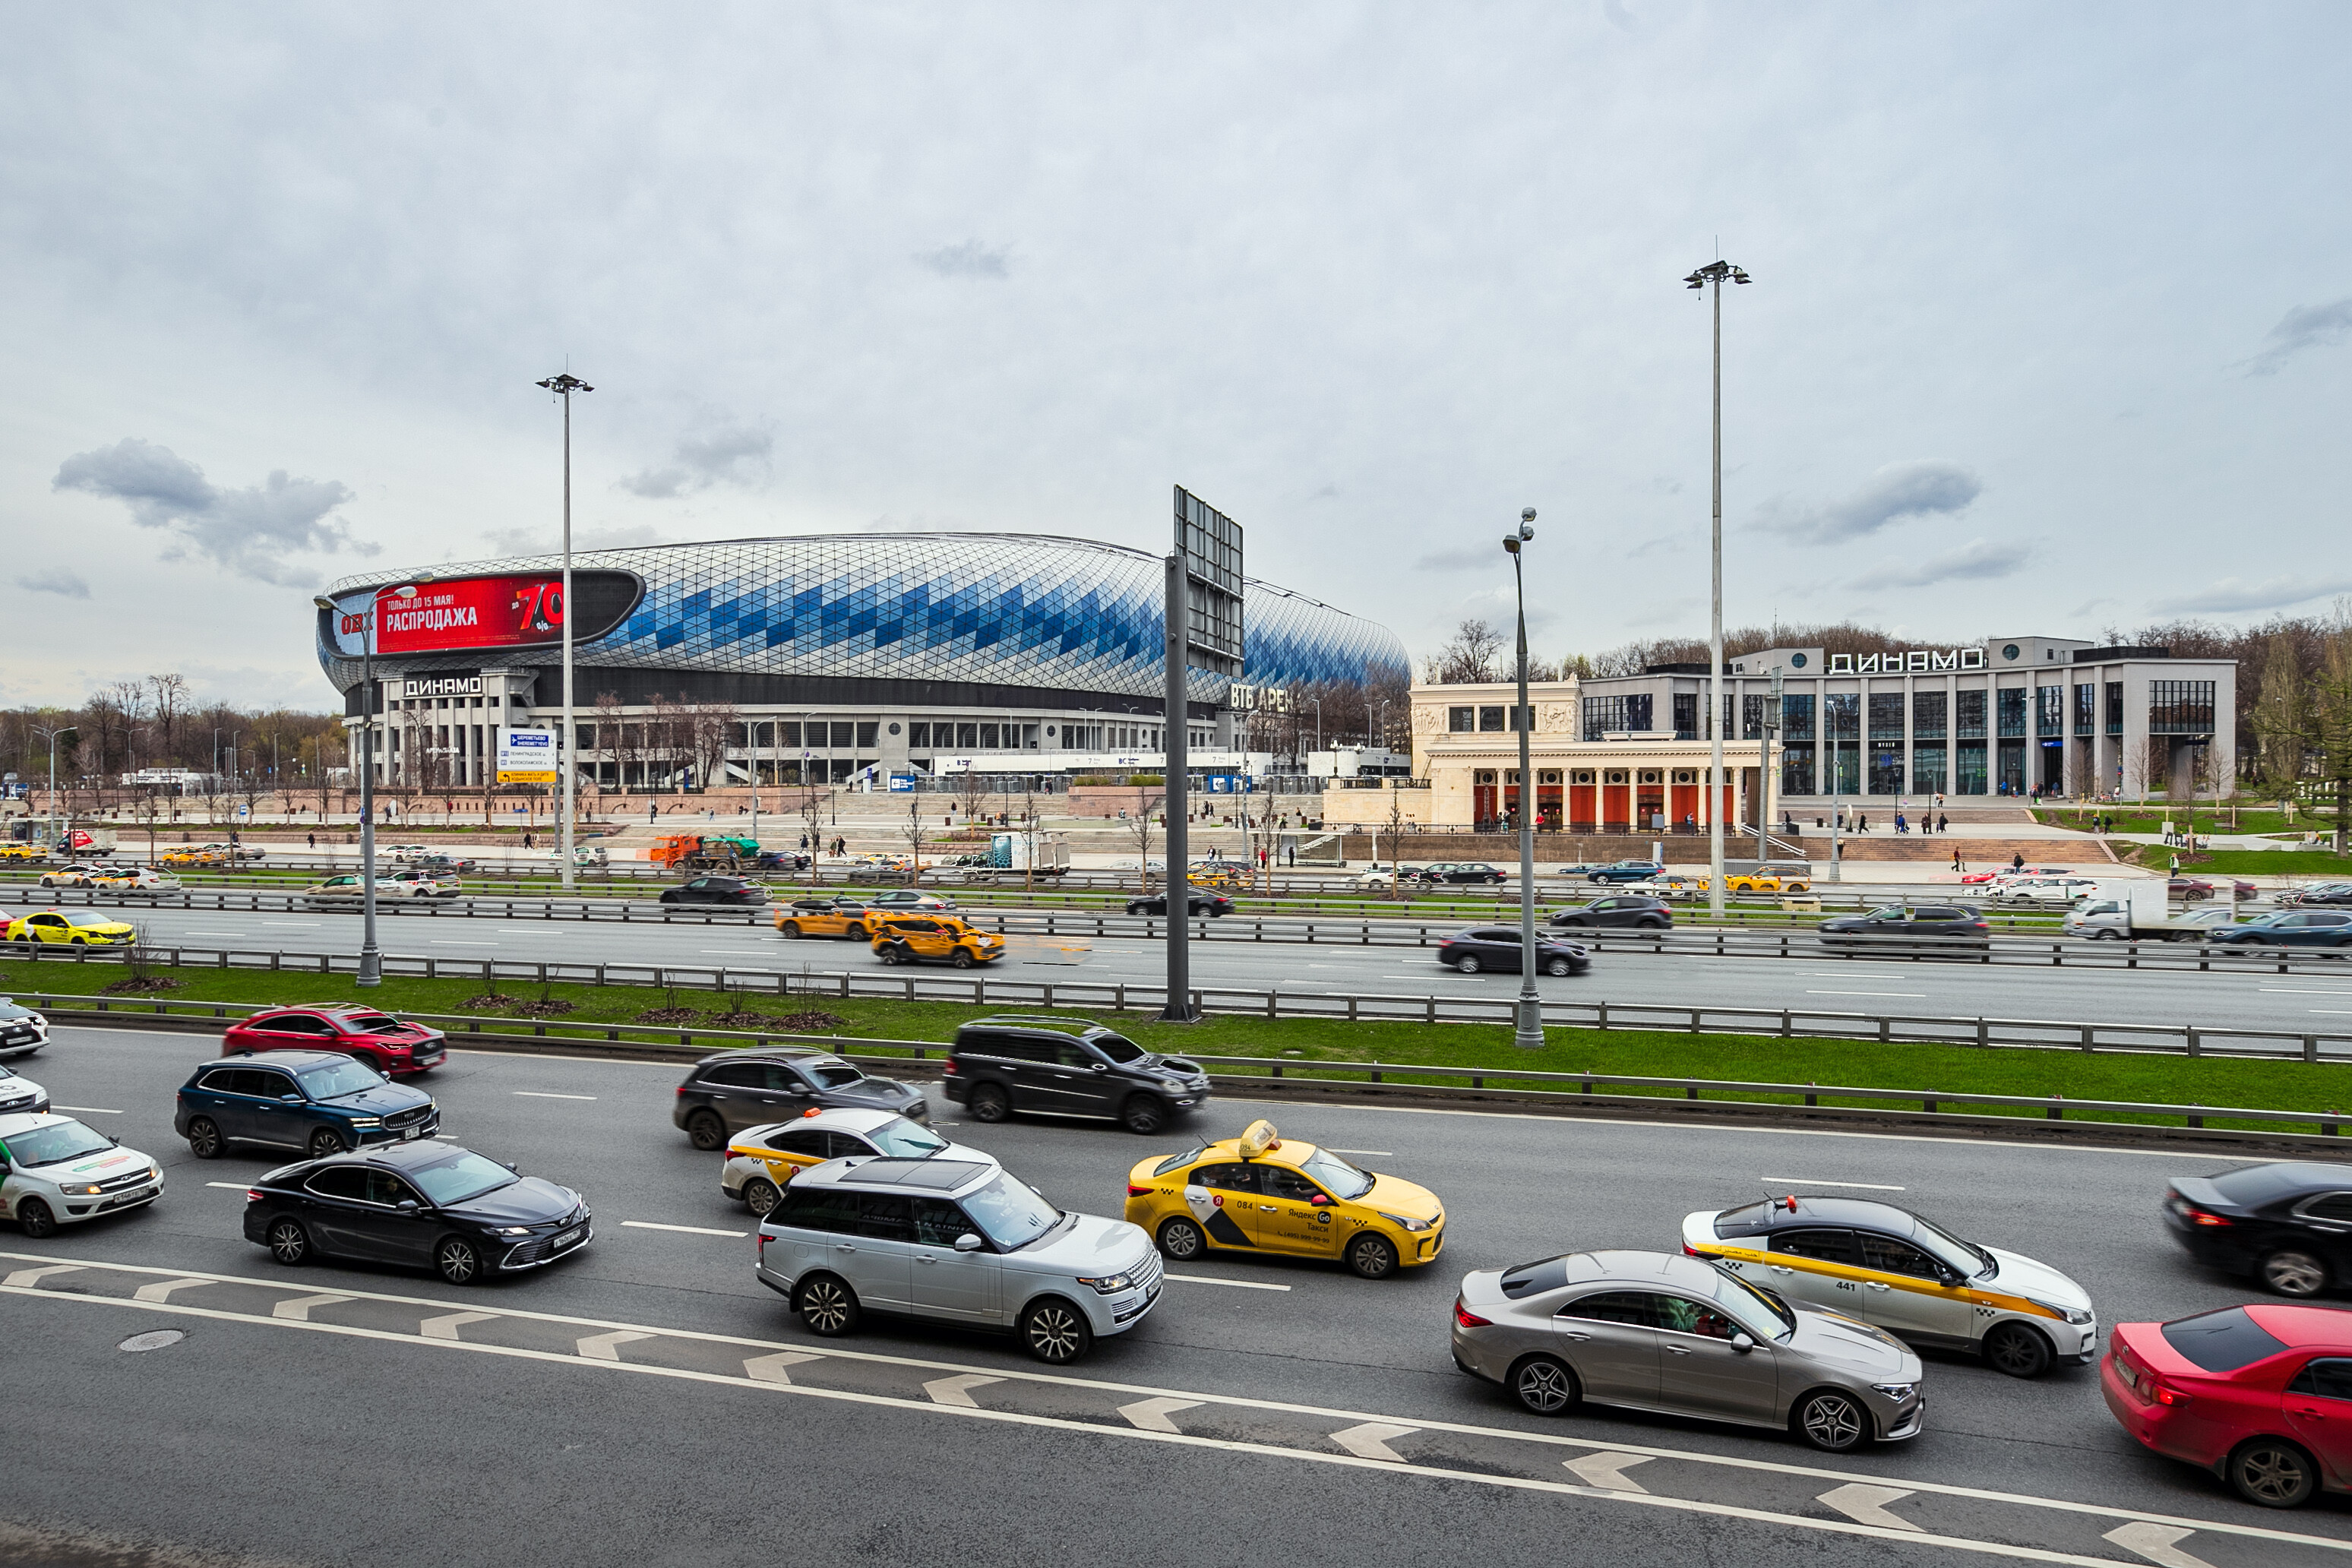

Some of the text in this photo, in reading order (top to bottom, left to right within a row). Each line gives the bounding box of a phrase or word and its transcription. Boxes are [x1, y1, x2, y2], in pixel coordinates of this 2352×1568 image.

[387, 594, 454, 611] ТОЛЬКО ДО 15 МАЯ!
[517, 582, 564, 630] 70
[387, 606, 478, 633] РАСПРОДАЖА
[1829, 648, 1984, 675] ДИНАМО
[405, 677, 482, 697] ДИНАМО
[1231, 682, 1254, 710] ВТБ
[1236, 1200, 1253, 1210] 084
[1288, 1208, 1330, 1222] Яндекс Go
[1307, 1222, 1329, 1233] Такси
[1284, 1231, 1330, 1244] (495) 999-99-99
[1835, 1281, 1855, 1292] 441
